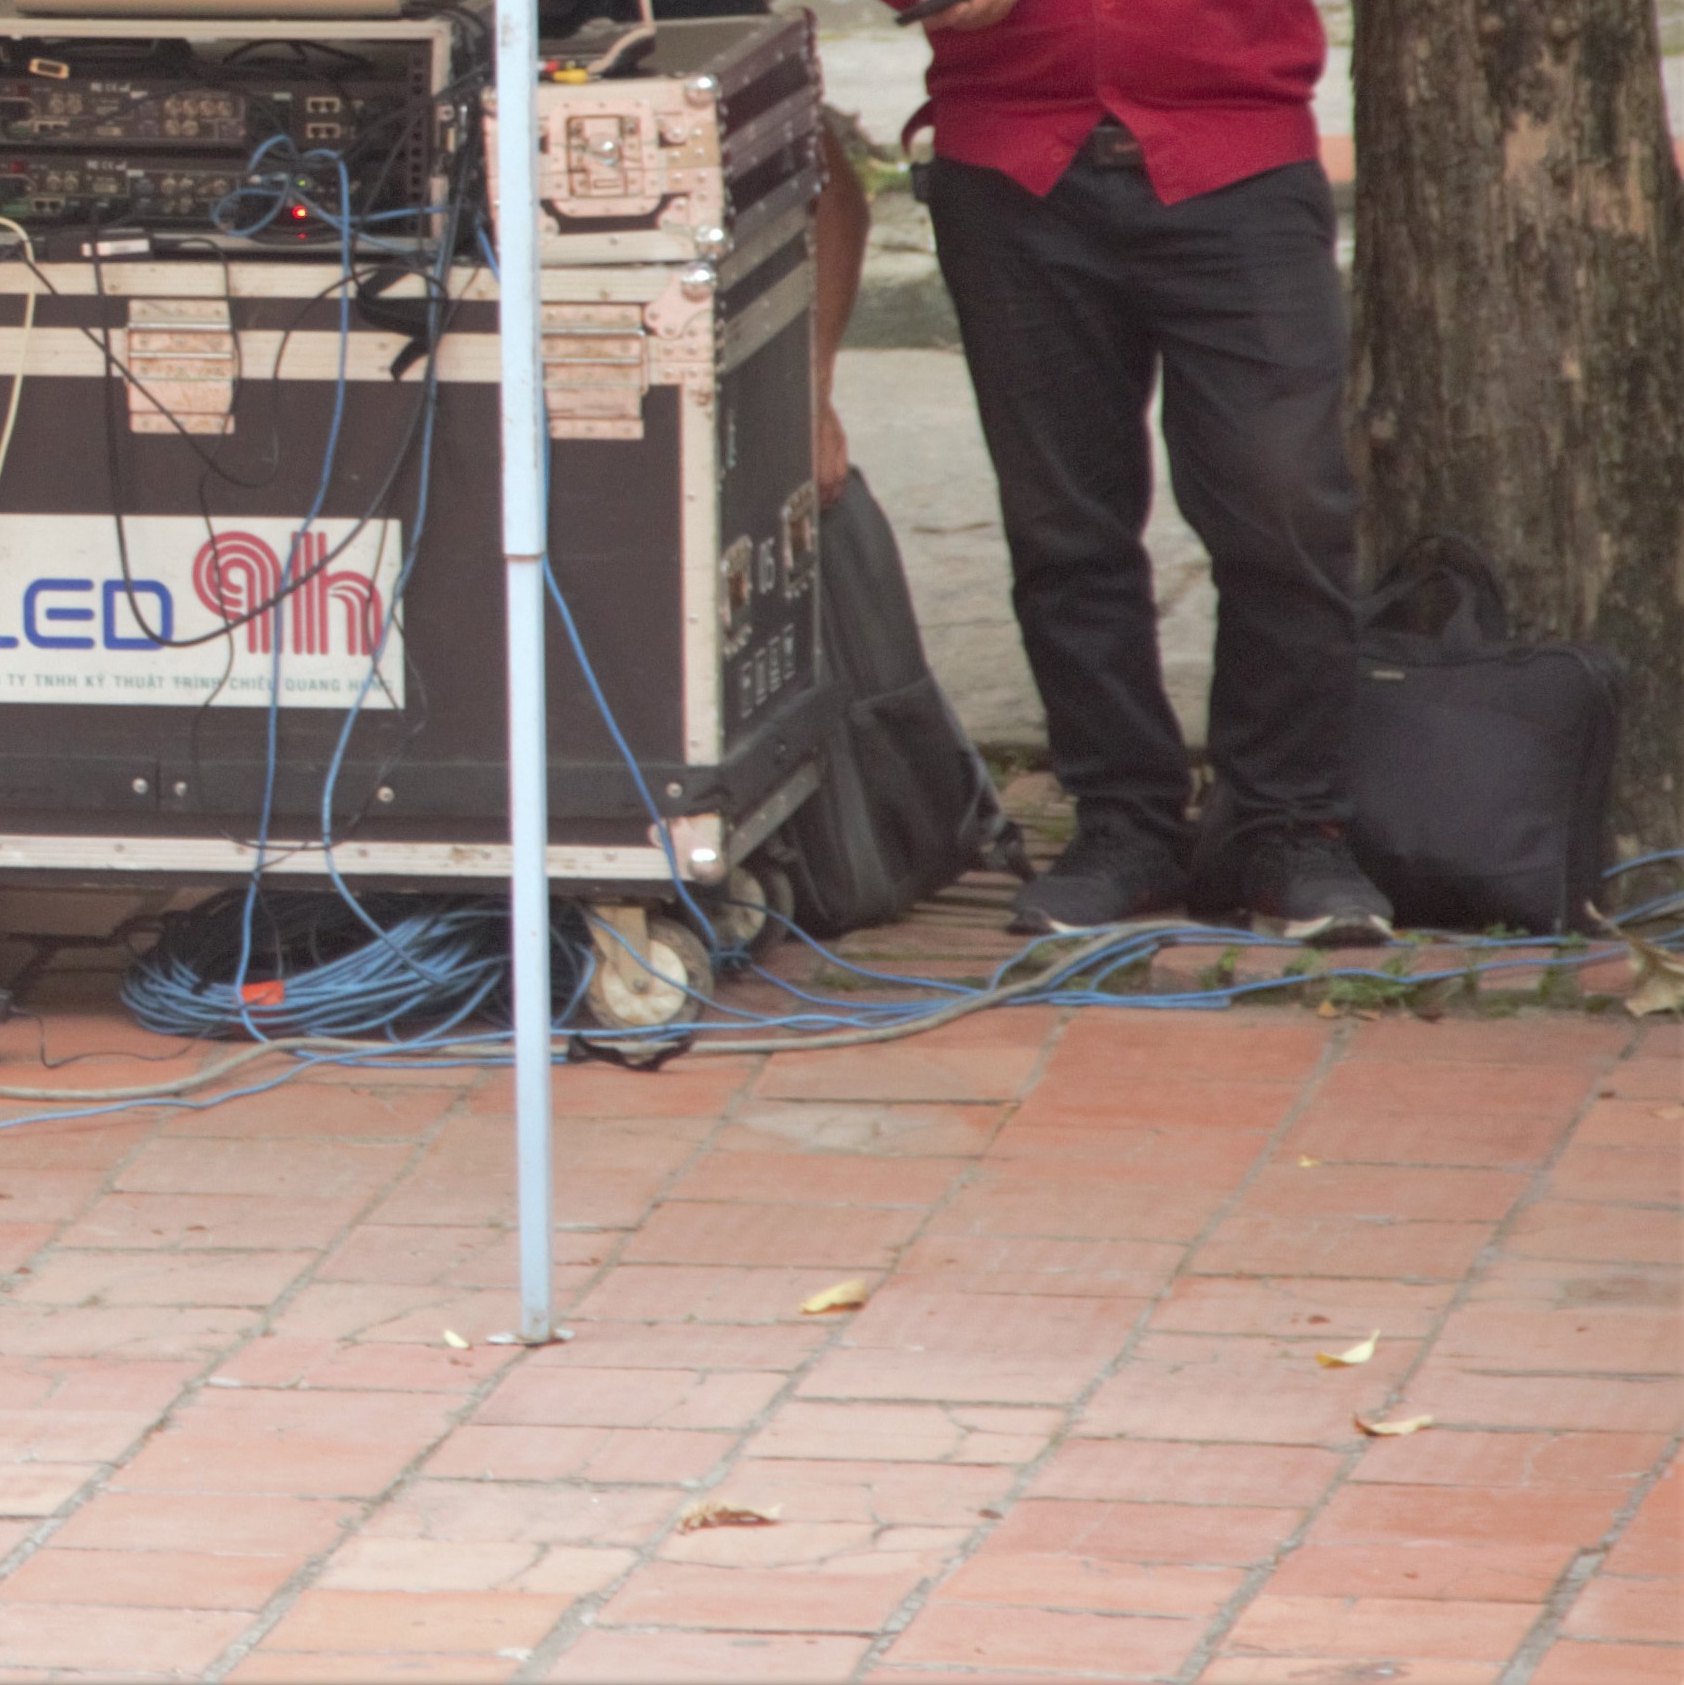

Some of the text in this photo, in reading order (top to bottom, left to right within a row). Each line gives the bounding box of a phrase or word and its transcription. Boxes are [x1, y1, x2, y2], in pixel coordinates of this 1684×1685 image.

[8, 673, 26, 687] TY
[34, 673, 77, 688] TNHH
[285, 676, 340, 692] QUANG
[348, 676, 393, 693] HNG
